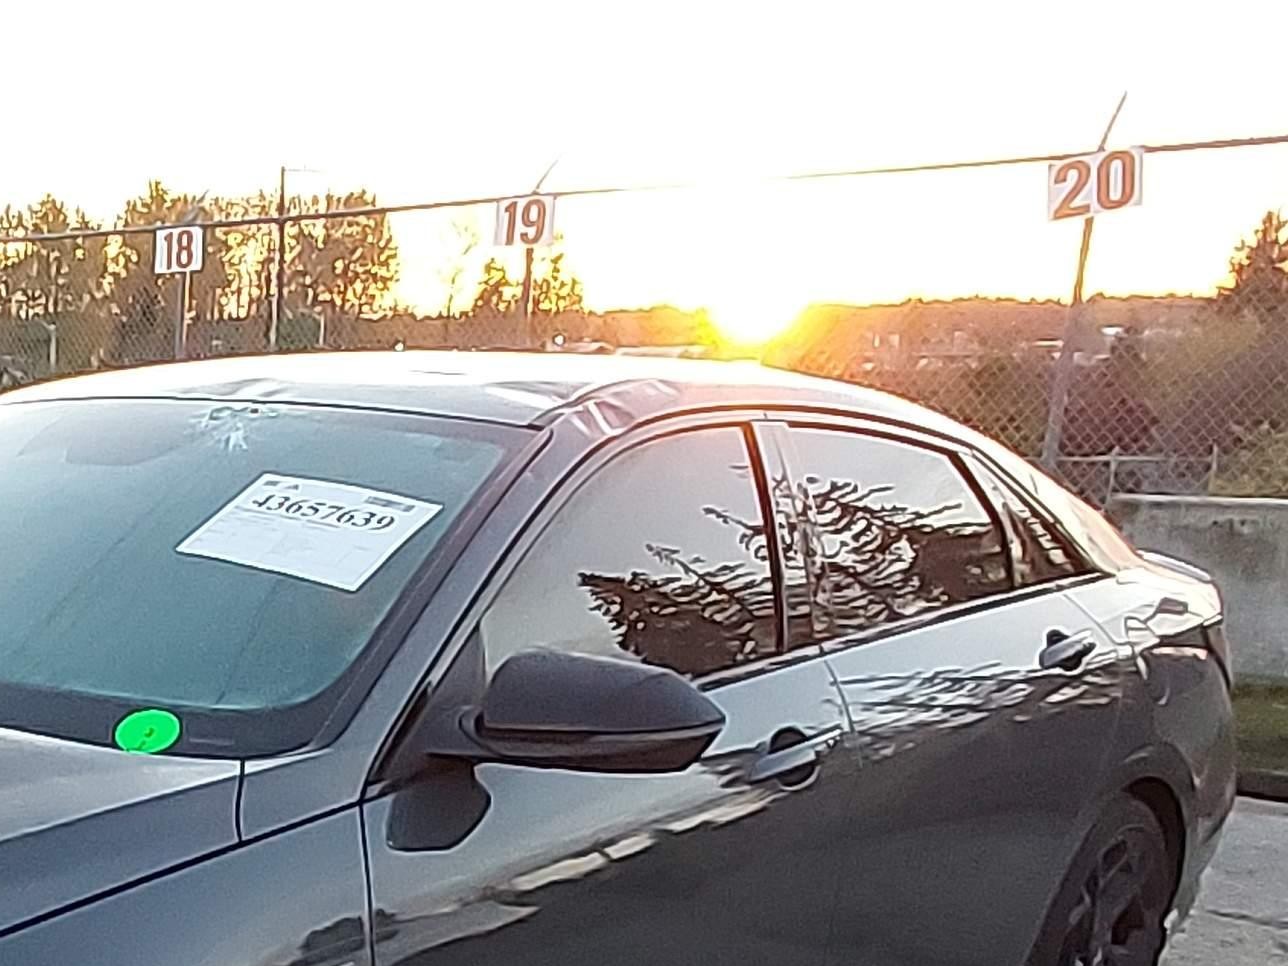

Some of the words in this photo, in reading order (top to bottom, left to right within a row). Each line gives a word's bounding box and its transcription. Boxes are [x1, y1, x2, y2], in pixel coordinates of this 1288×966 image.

[1053, 150, 1136, 220] 20
[505, 198, 546, 246] 19
[164, 230, 194, 270] 18
[251, 493, 396, 531] 43657639
